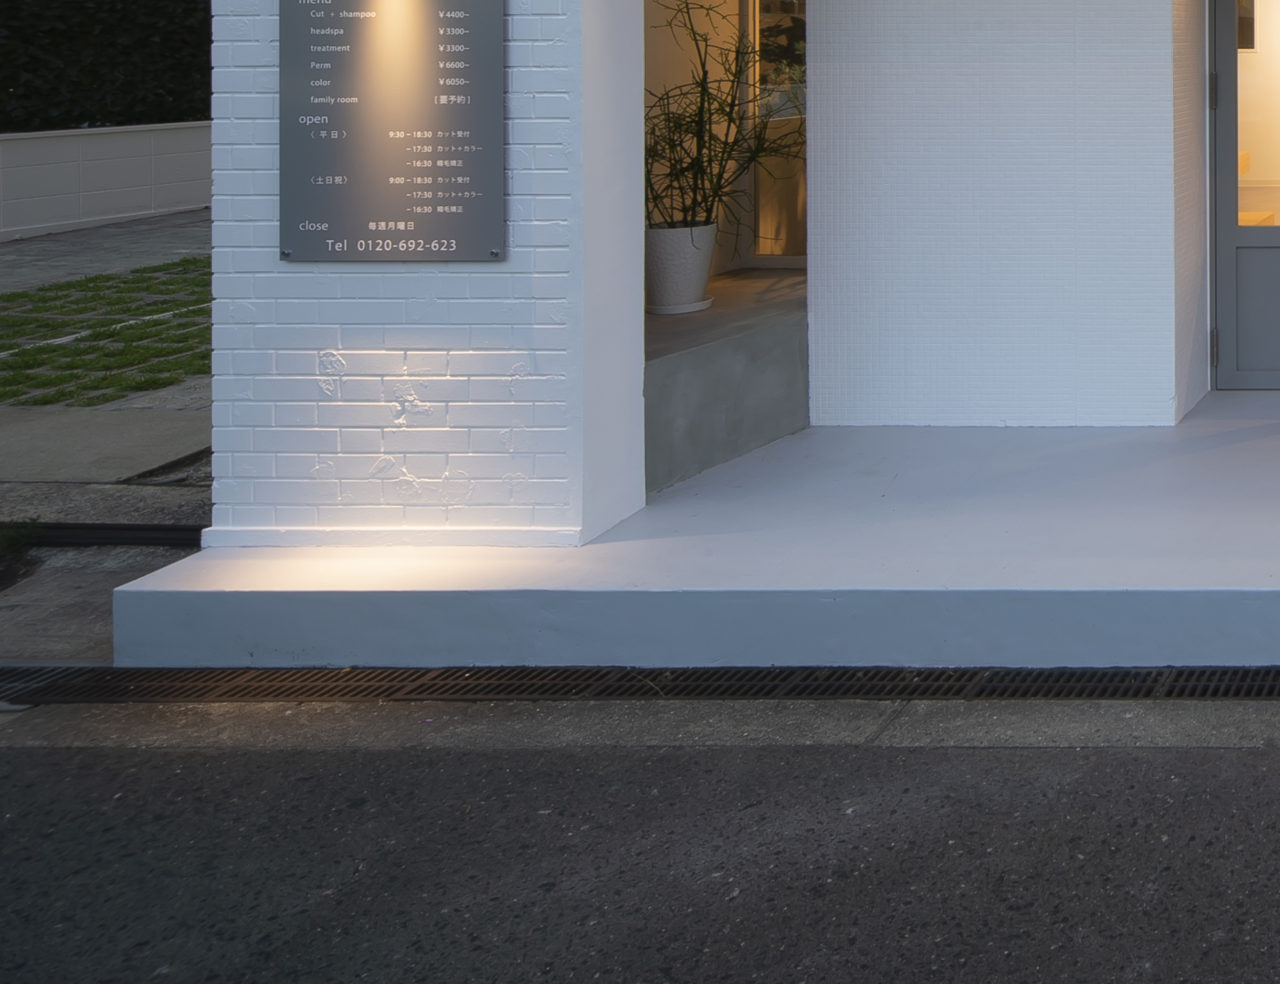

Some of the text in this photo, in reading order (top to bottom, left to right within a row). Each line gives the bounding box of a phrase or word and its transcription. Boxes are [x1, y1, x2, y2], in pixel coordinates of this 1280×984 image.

[310, 10, 325, 18] Cut
[339, 10, 377, 20] shampoo
[310, 27, 344, 36] headspa
[310, 44, 351, 53] treatment
[310, 61, 332, 70] Perm
[310, 78, 332, 87] color
[310, 95, 335, 105] family
[298, 115, 329, 125] open
[298, 220, 415, 231] close 毎週月曜日
[326, 239, 457, 252] Tel 0120-692-623
